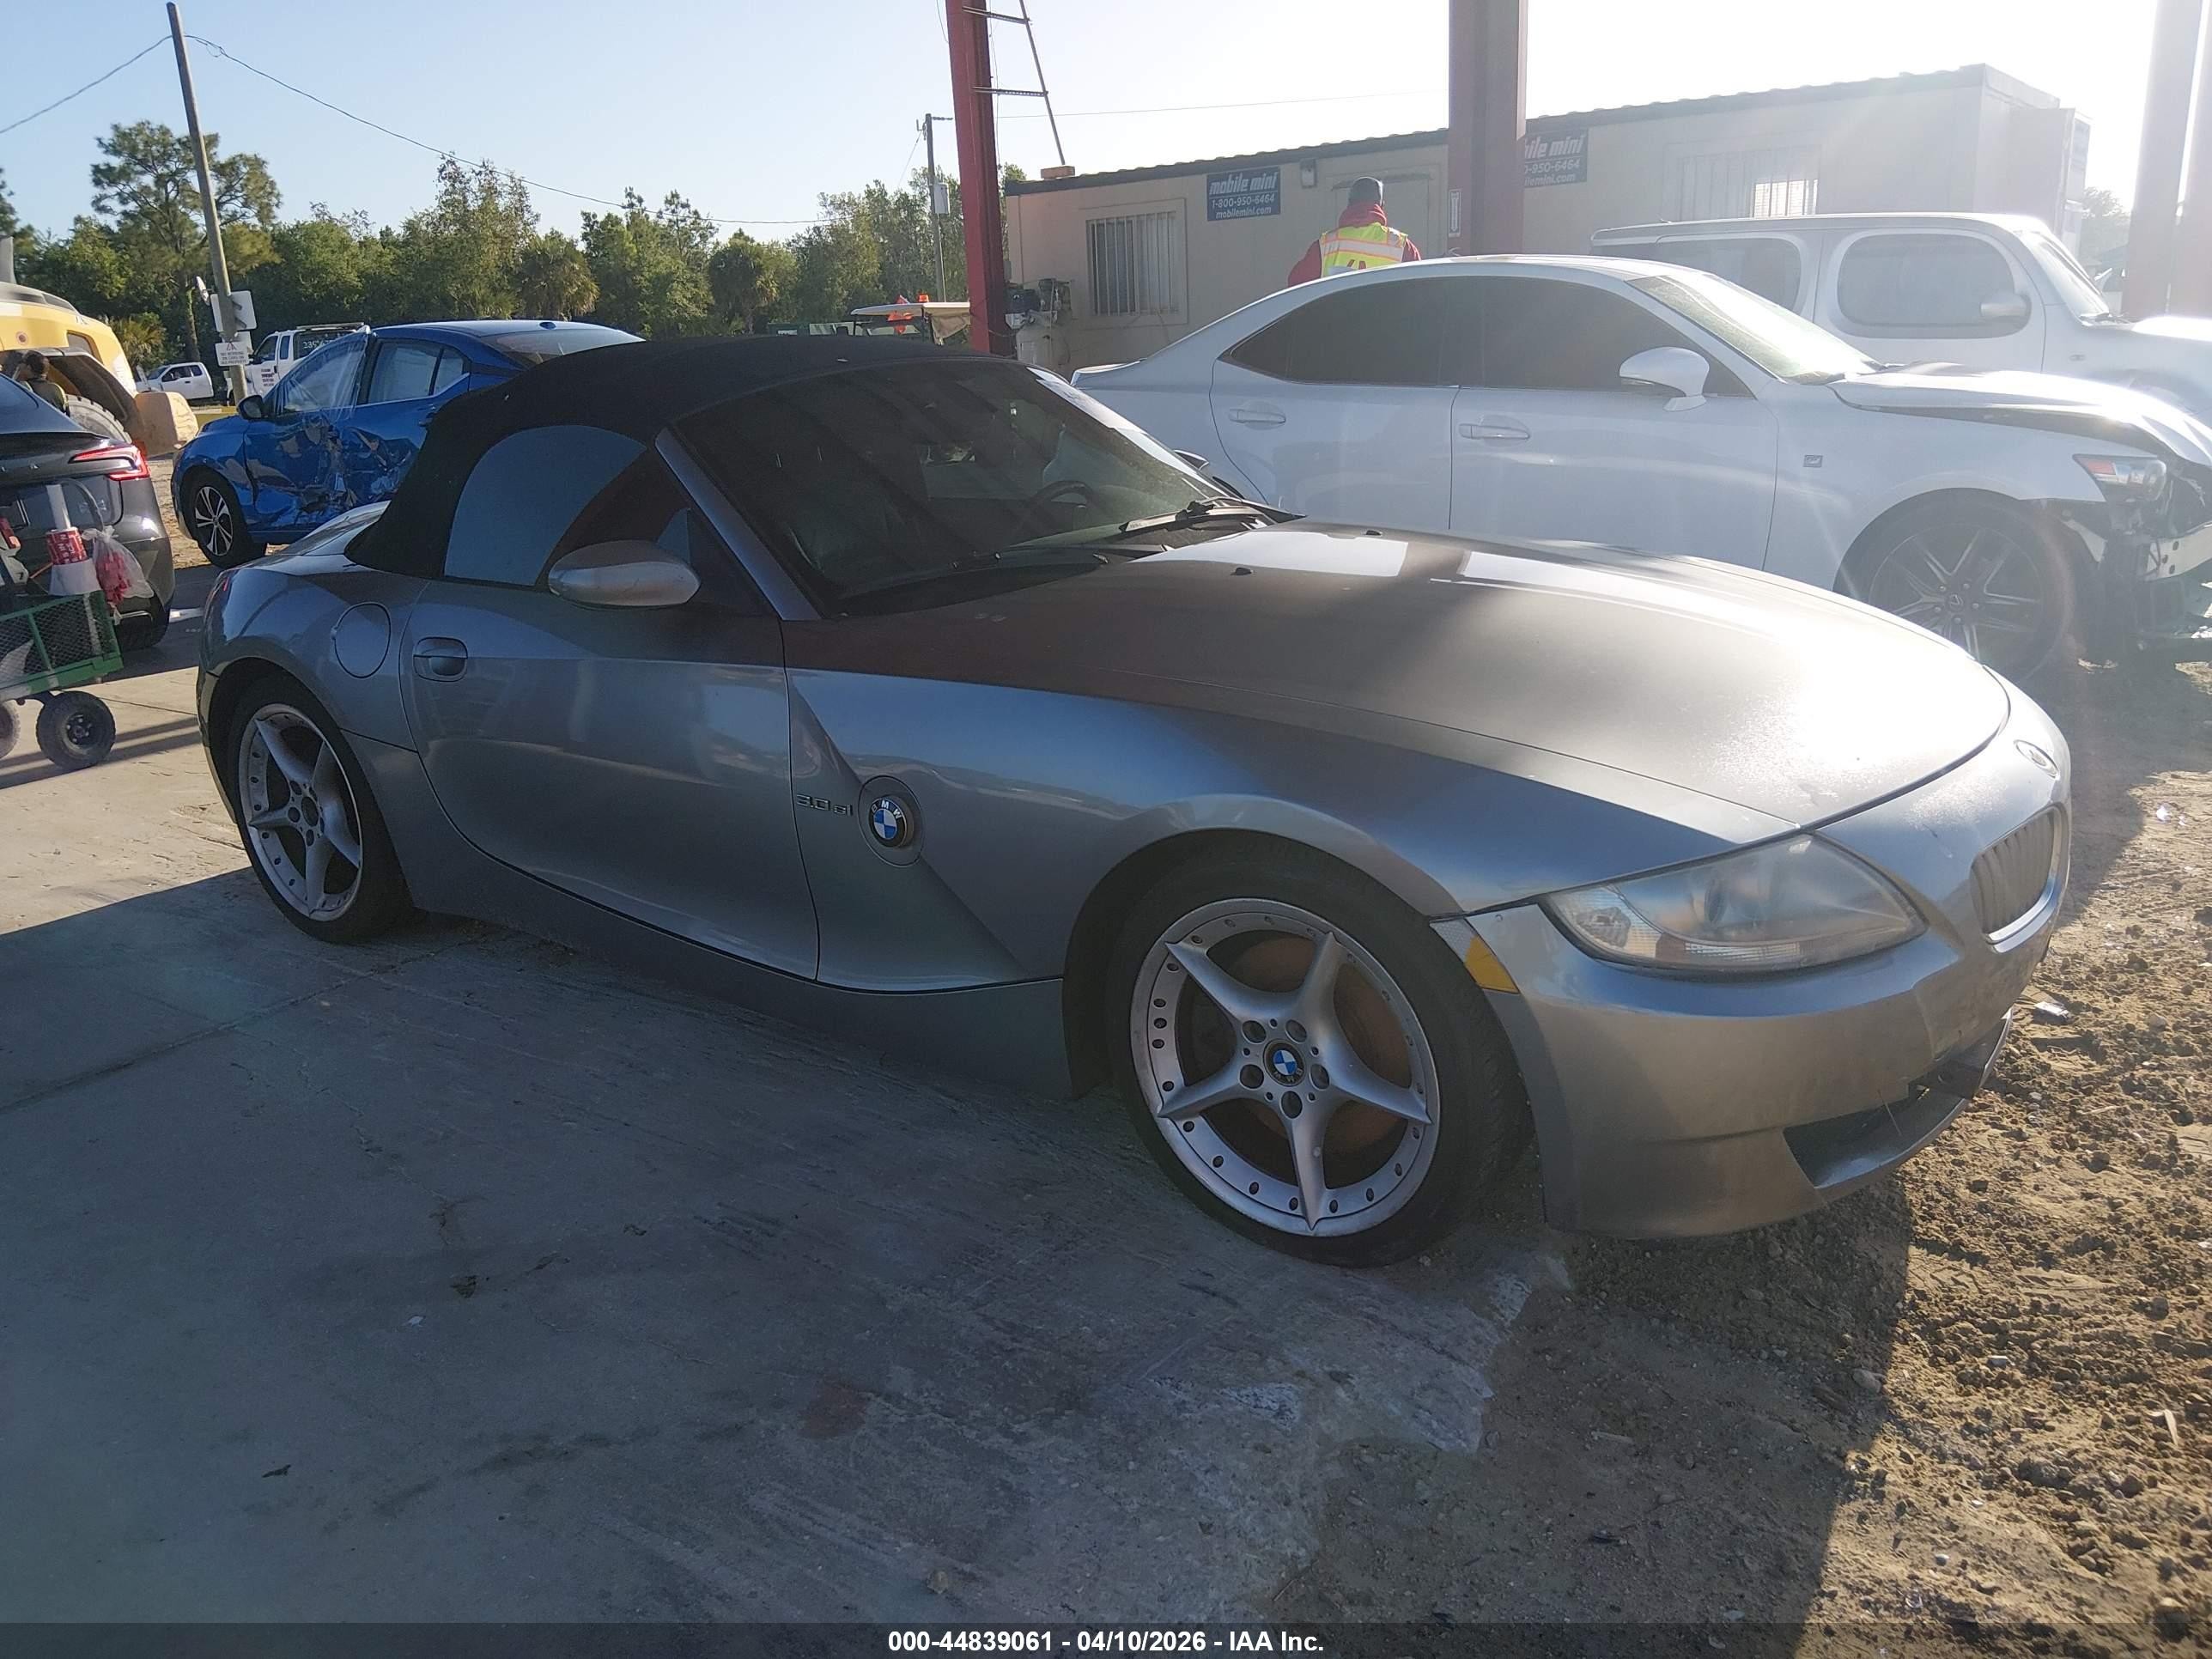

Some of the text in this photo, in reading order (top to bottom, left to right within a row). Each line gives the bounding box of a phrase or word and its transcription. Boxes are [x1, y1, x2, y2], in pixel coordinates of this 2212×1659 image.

[1548, 135, 1585, 156] mini
[1209, 172, 1279, 195] mobile mini
[1216, 207, 1272, 219] mobilemini.com
